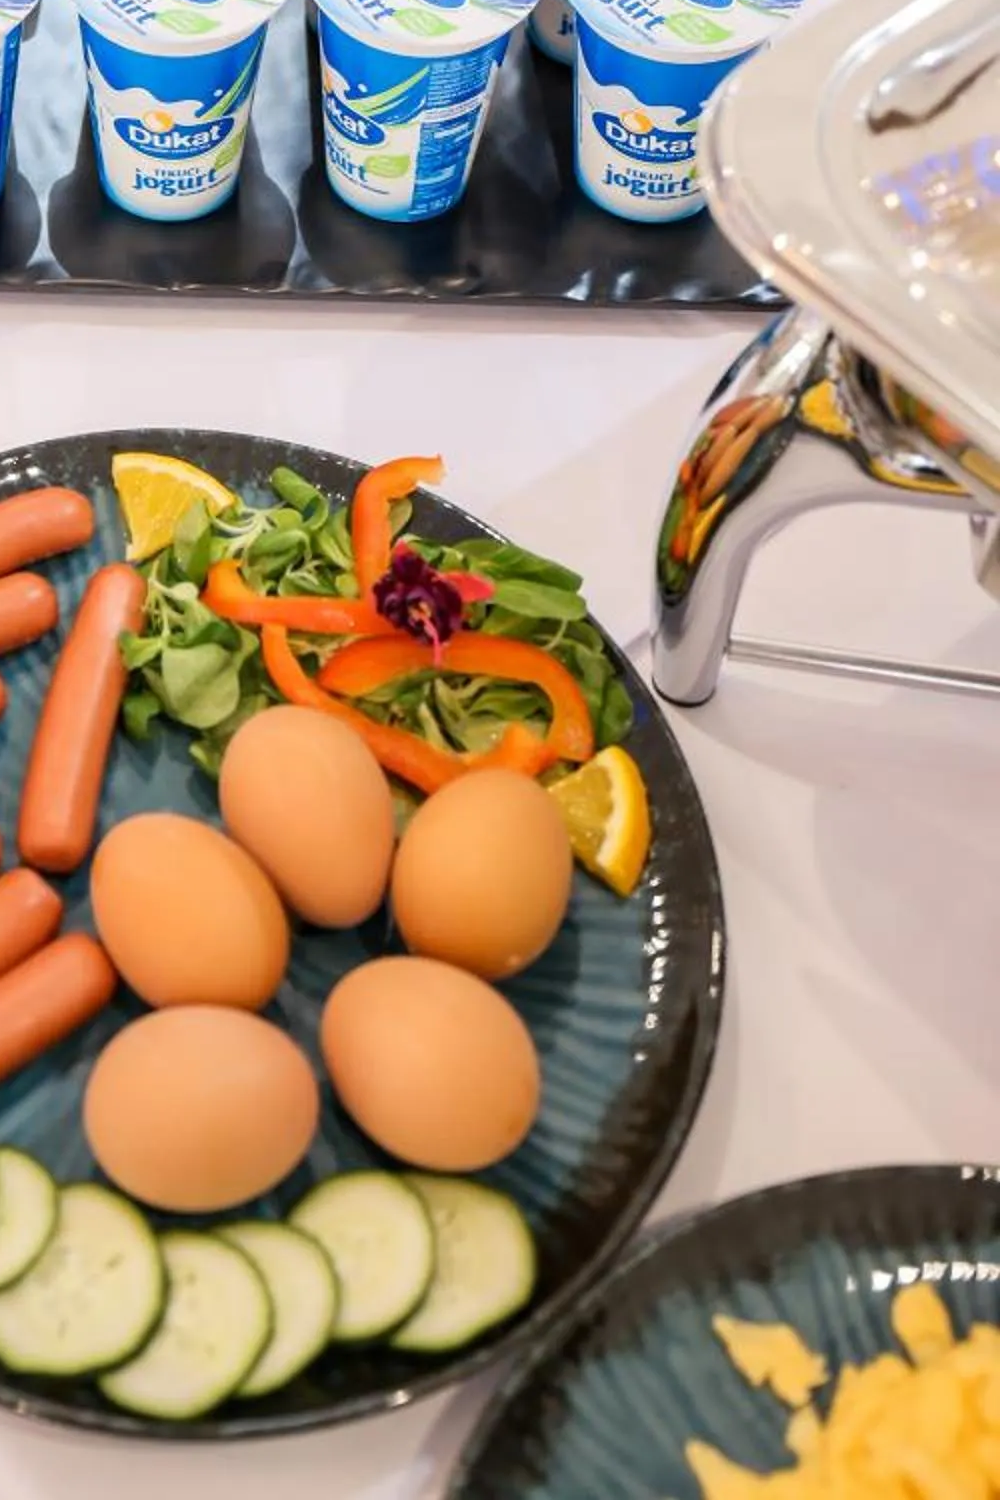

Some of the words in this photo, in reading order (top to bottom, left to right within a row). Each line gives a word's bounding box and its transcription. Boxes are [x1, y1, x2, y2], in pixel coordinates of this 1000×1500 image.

[128, 125, 221, 149] Dukat
[132, 167, 217, 197] jogurt
[602, 163, 692, 197] jogurt
